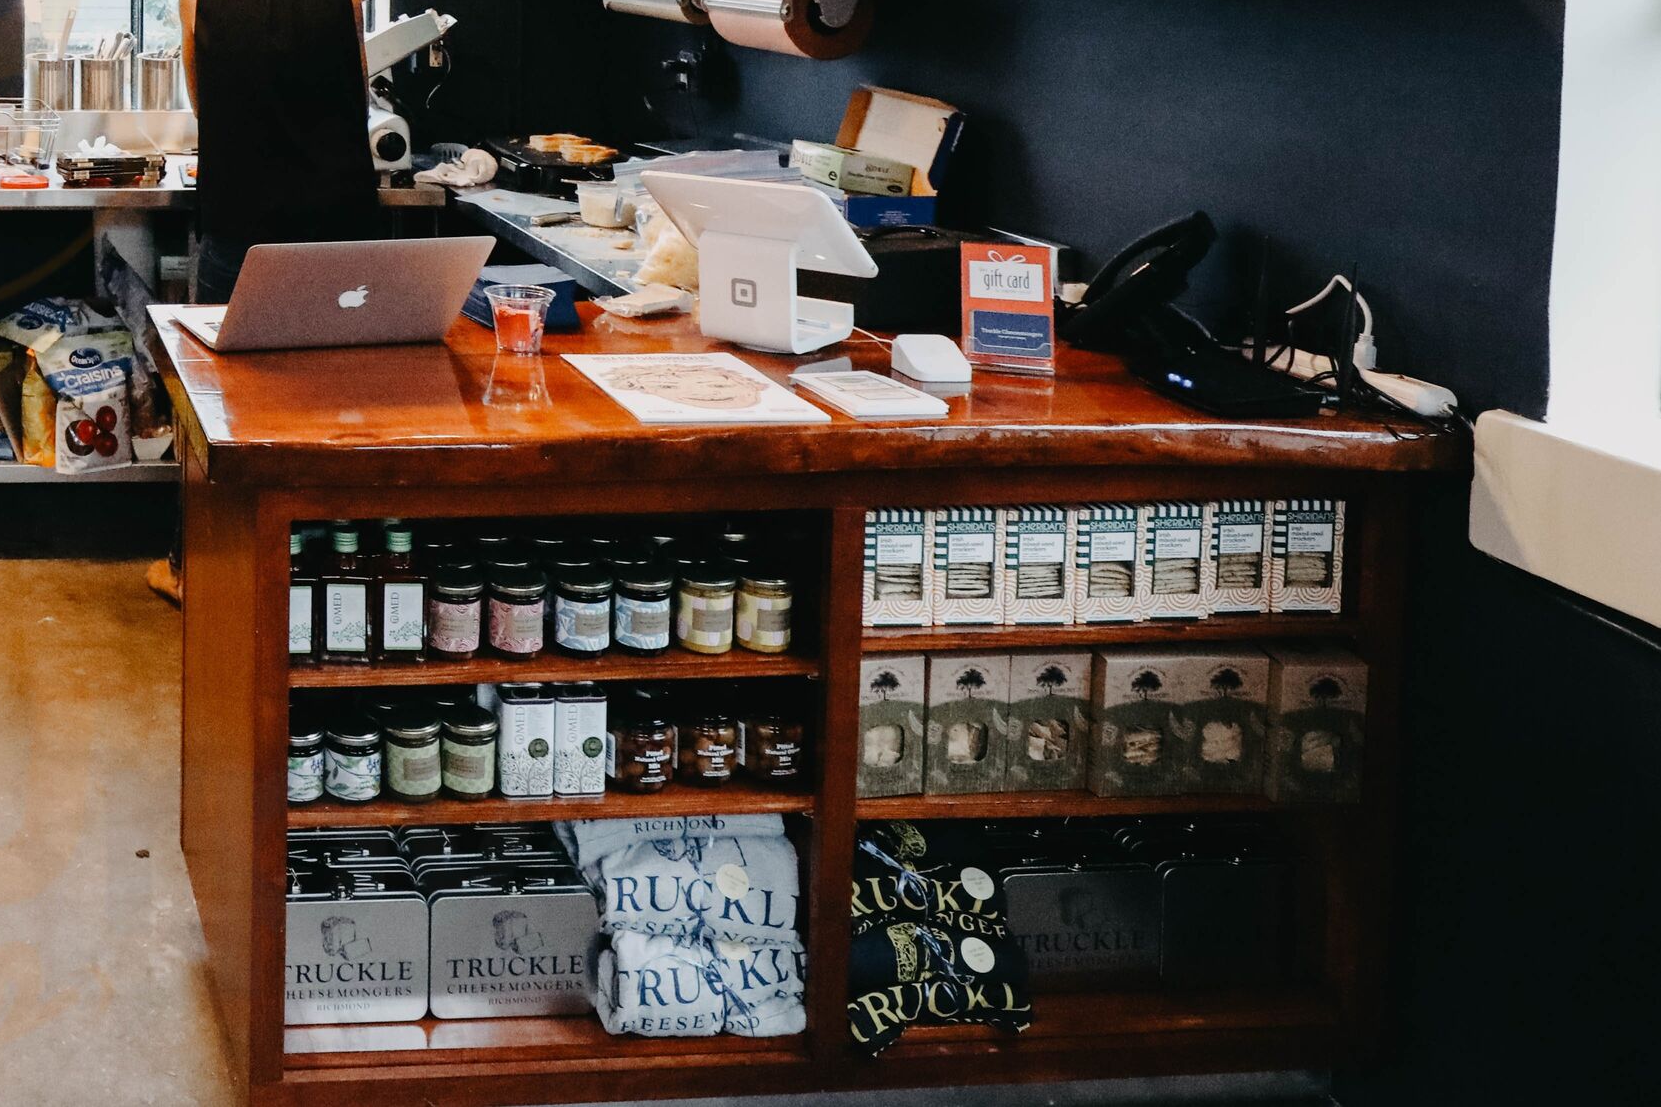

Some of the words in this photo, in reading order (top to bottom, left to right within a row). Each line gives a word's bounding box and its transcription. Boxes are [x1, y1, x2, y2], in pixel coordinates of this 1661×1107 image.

[983, 269, 1003, 291] gift
[1006, 270, 1030, 289] card
[64, 365, 124, 390] Craisins
[634, 818, 726, 834] RICHMOND
[446, 955, 584, 979] TRUCKLE
[286, 986, 412, 1000] HEESEMONGERS
[446, 979, 583, 995] CHEESEMONGERS
